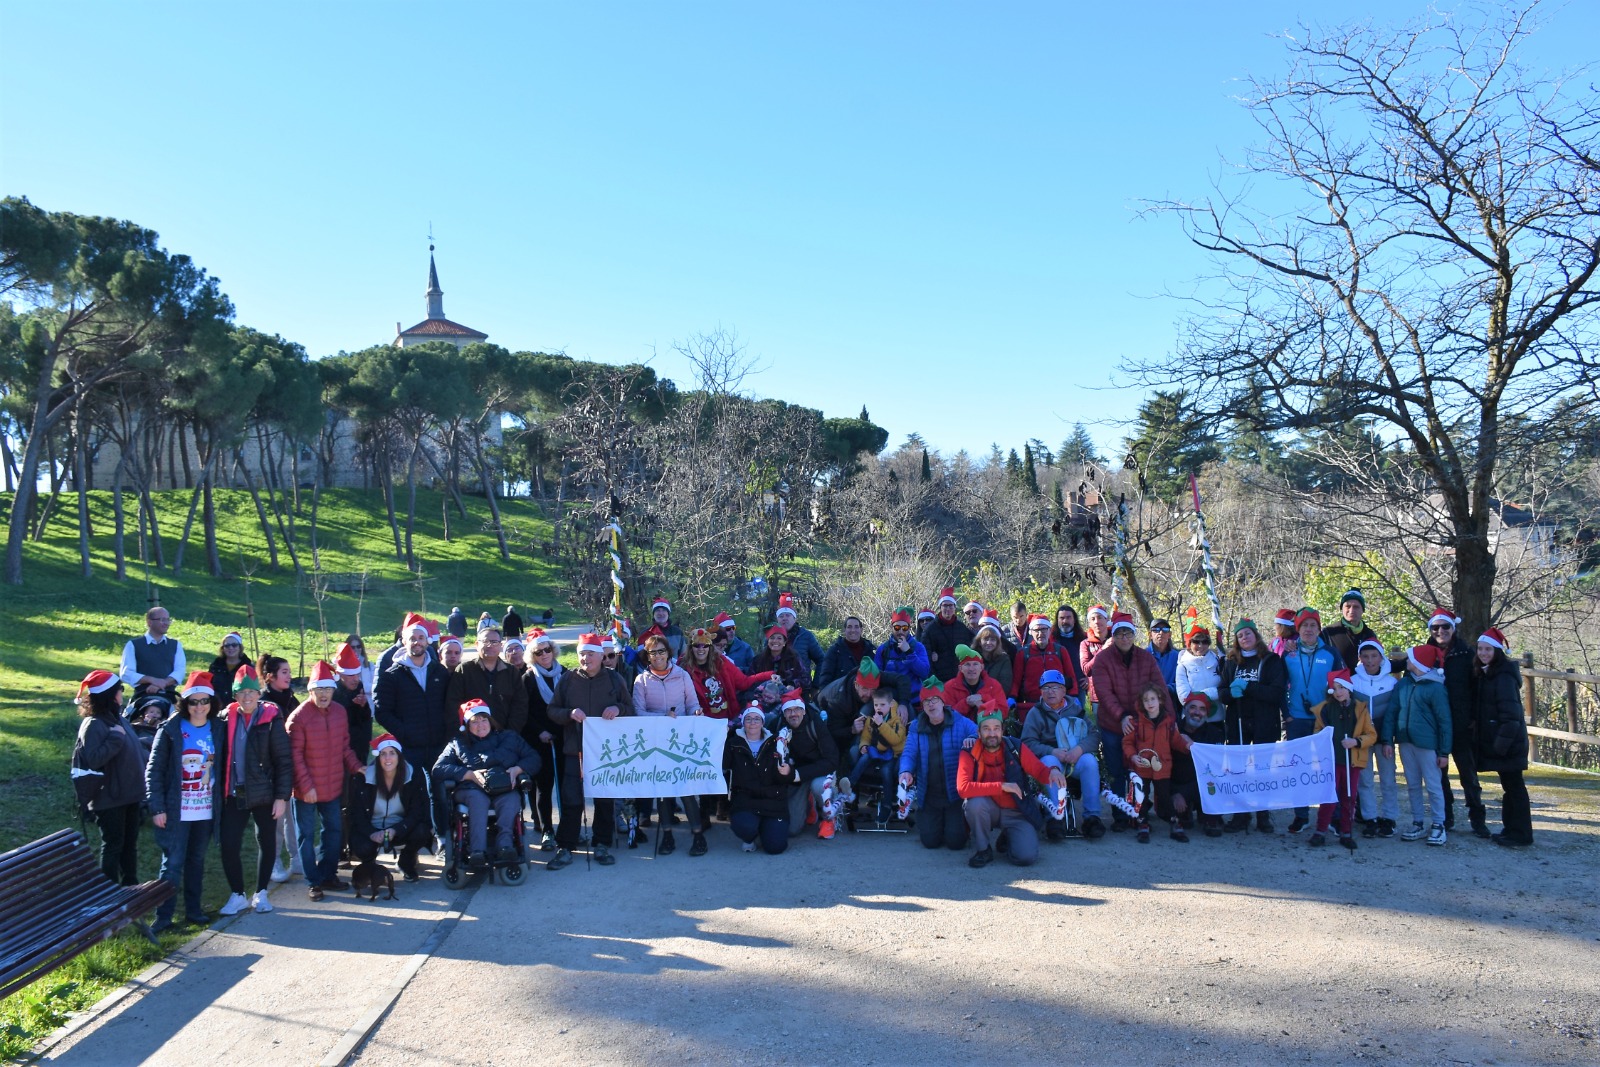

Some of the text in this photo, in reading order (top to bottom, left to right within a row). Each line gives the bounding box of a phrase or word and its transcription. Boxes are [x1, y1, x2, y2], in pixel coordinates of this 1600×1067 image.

[1216, 770, 1333, 795] Villaviciosa de Odón
